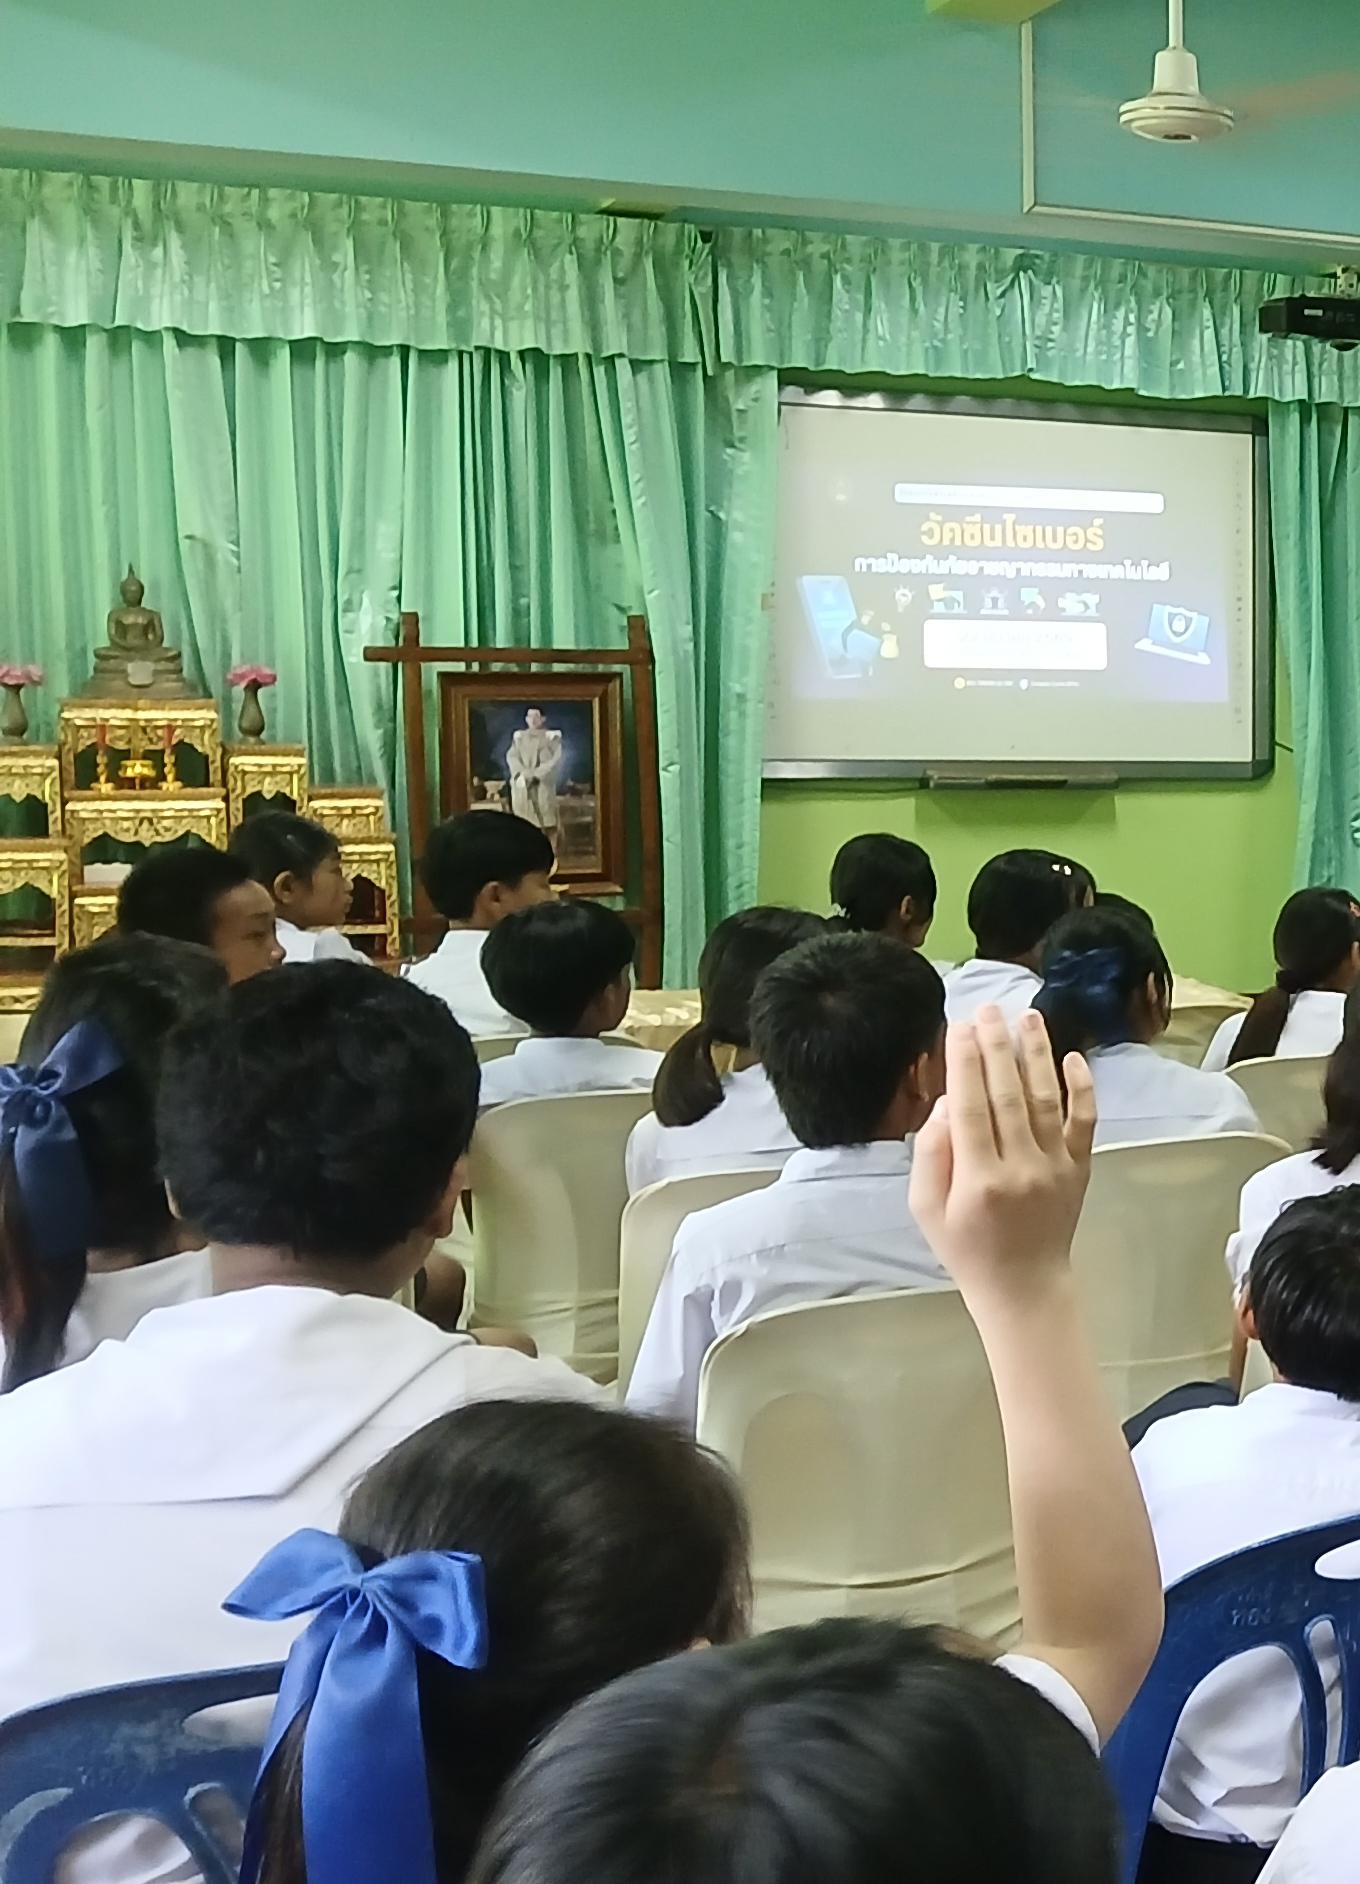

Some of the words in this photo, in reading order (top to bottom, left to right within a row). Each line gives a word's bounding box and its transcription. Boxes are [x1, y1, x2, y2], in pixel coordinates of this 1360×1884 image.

[920, 512, 1105, 551] วัคซีนไซเบอร์
